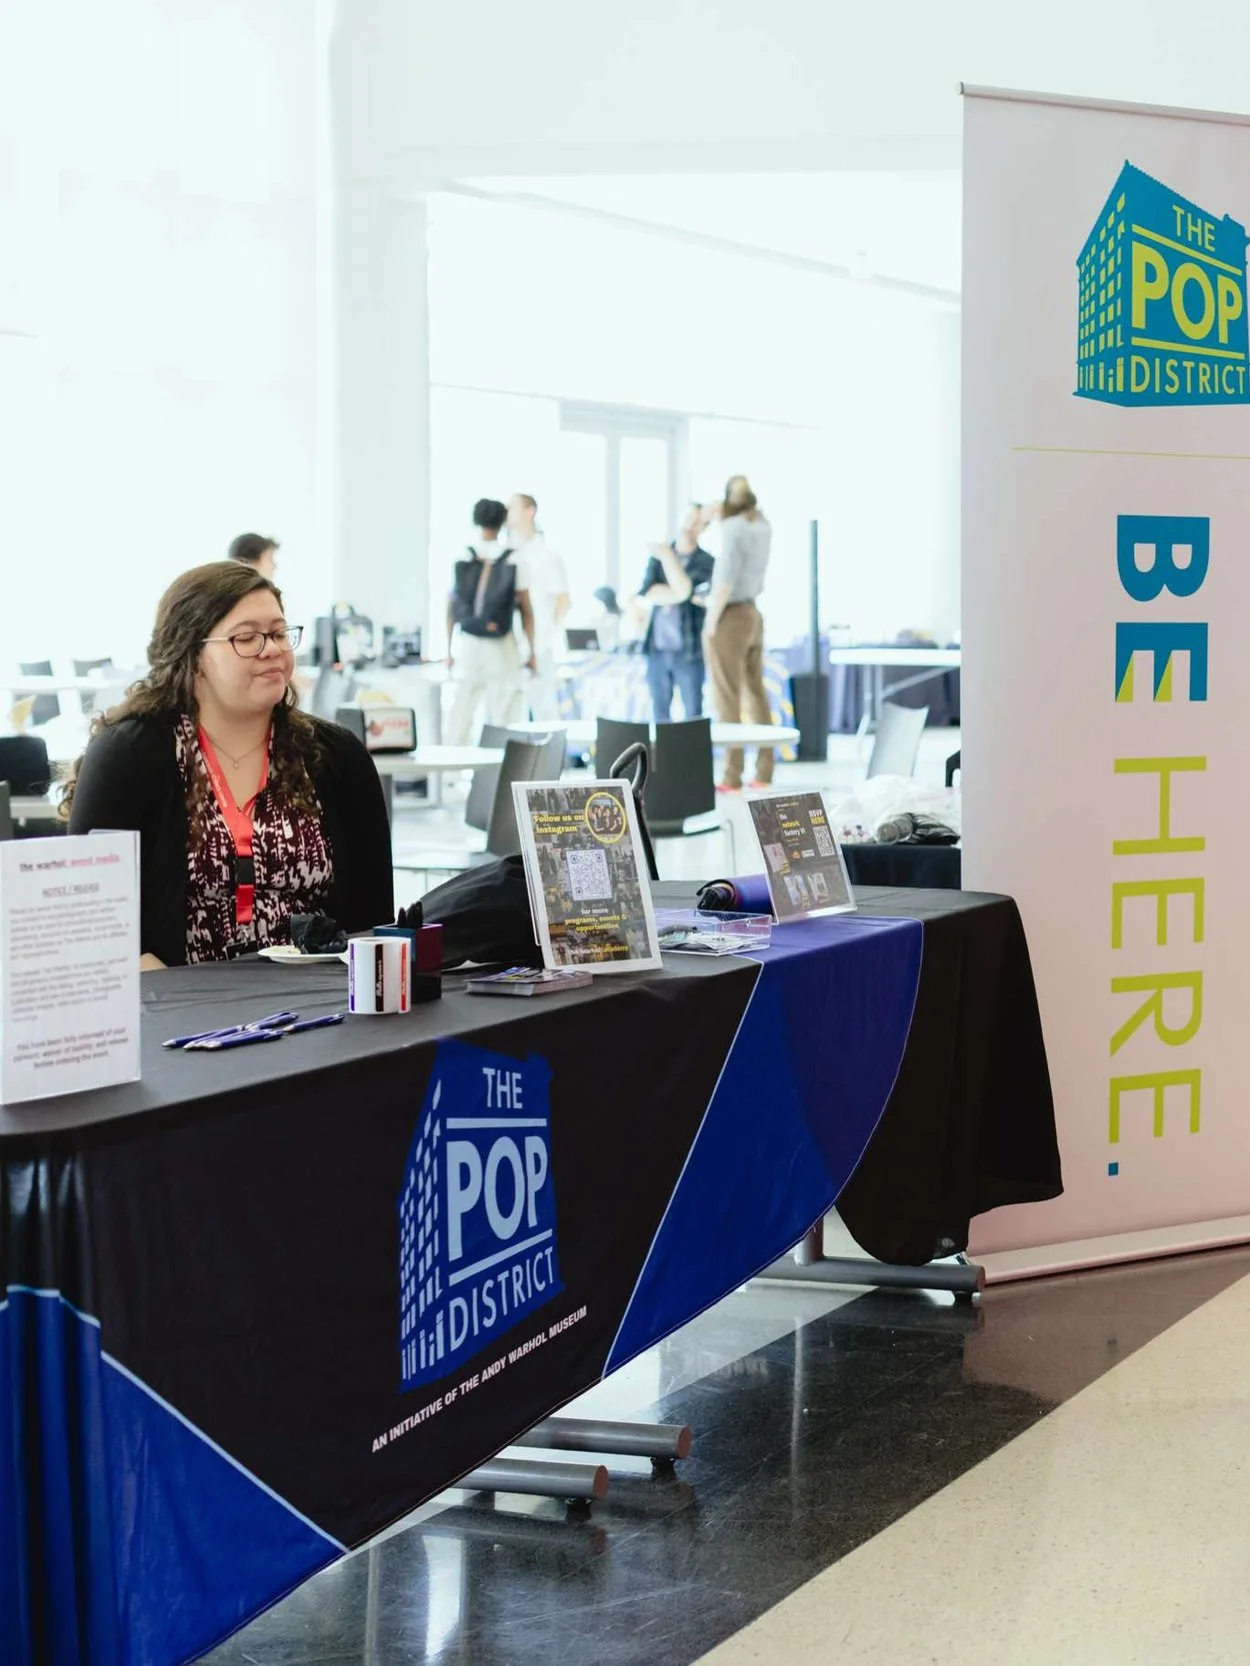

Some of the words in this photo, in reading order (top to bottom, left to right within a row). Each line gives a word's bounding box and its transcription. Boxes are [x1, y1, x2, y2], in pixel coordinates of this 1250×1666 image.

[1172, 204, 1216, 252] THE
[1131, 240, 1243, 344] POP
[1130, 355, 1246, 395] DISTRICT
[1115, 514, 1210, 702] BE
[533, 813, 561, 823] Follow
[1108, 755, 1208, 1177] HERE.
[482, 1067, 523, 1109] THE
[446, 1136, 548, 1261] POP
[449, 1246, 554, 1352] DISTRICT
[372, 1433, 388, 1452] AN
[389, 1396, 443, 1442] INITIATIVE
[444, 1389, 459, 1406] OF
[459, 1374, 480, 1396] THE
[481, 1356, 507, 1383] ANDY
[508, 1332, 548, 1365] WARHOL
[549, 1305, 588, 1339] MUSEUM
